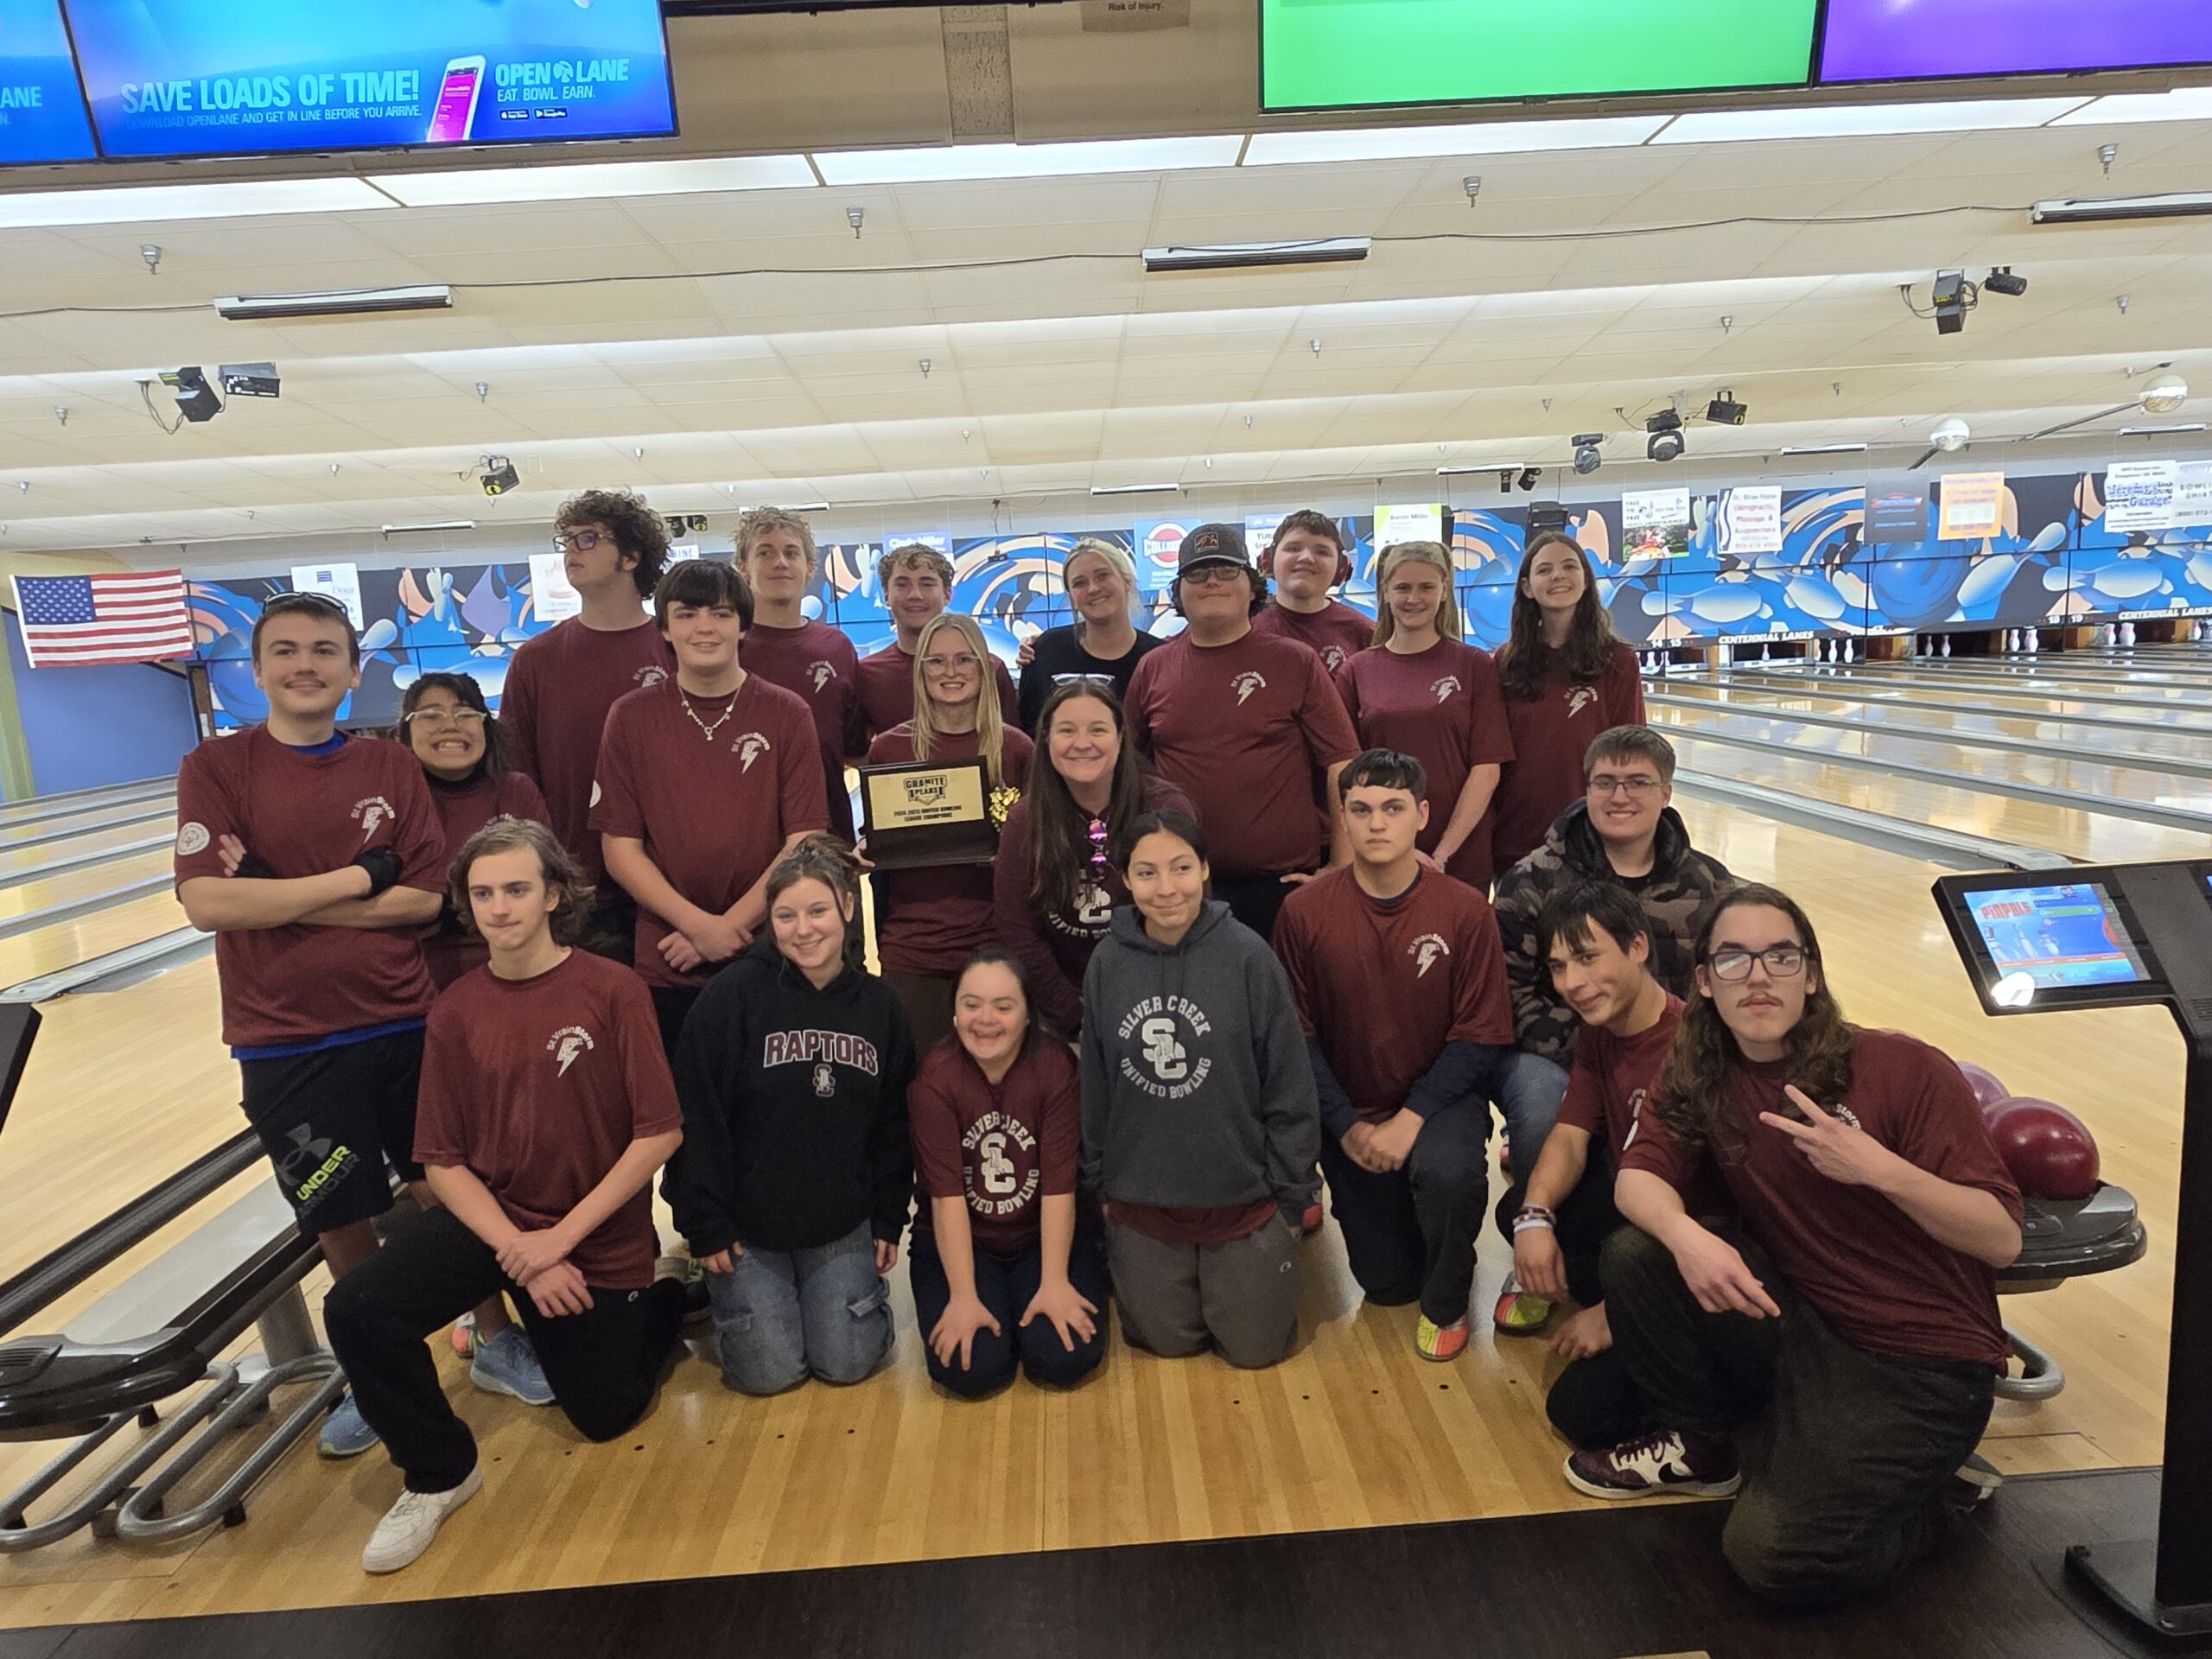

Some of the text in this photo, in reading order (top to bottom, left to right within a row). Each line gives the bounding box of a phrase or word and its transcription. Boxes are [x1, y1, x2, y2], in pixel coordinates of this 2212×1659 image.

[495, 58, 630, 86] OPEN LANE
[0, 86, 42, 109] ANE
[120, 69, 419, 114] SAVE LOADS OF TIME!
[497, 86, 595, 103] EAT. BOWL. EARN.
[127, 105, 422, 129] DOWNLOAD OPENLANE AND GET IN LINE BEFORE YOU ARRIVE.
[1719, 630, 1815, 645] CENTENNIAL LANES
[906, 777, 944, 789] GRANITE
[1118, 995, 1211, 1039] SILVER CREEK
[763, 1029, 879, 1077] RAPTORS
[1121, 1057, 1211, 1099] UNIFIED BOWLING
[296, 1146, 351, 1200] UNDER
[996, 1168, 1040, 1215] BOWLING
